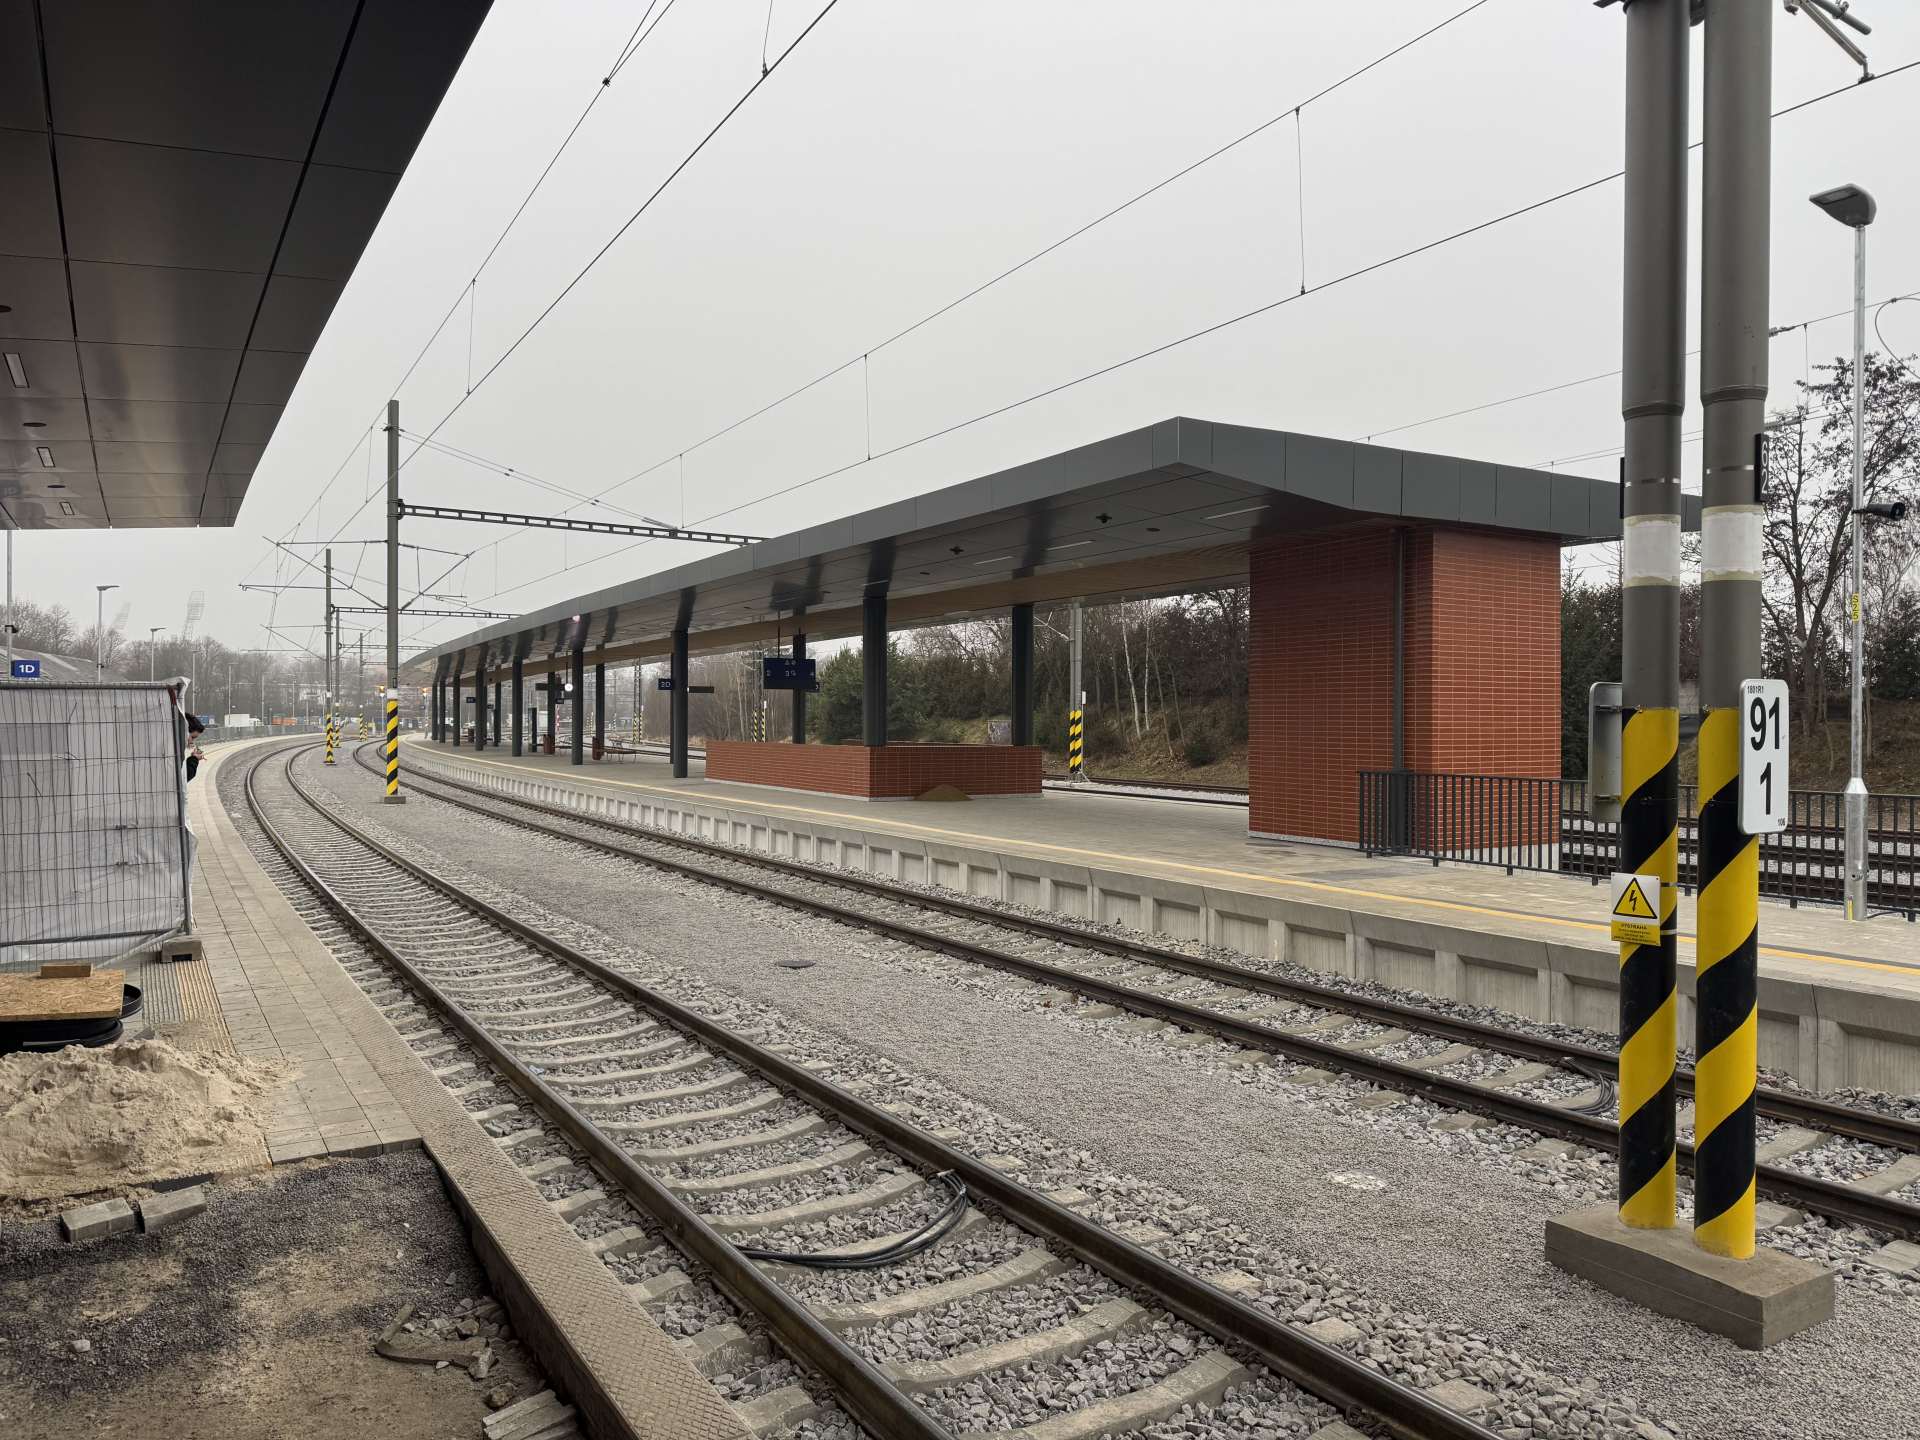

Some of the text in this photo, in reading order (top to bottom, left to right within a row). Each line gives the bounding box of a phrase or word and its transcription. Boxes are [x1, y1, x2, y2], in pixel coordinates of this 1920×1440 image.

[1761, 441, 1768, 494] 62
[18, 664, 35, 673] 1D
[1750, 697, 1780, 751] 91
[1760, 762, 1772, 815] 1
